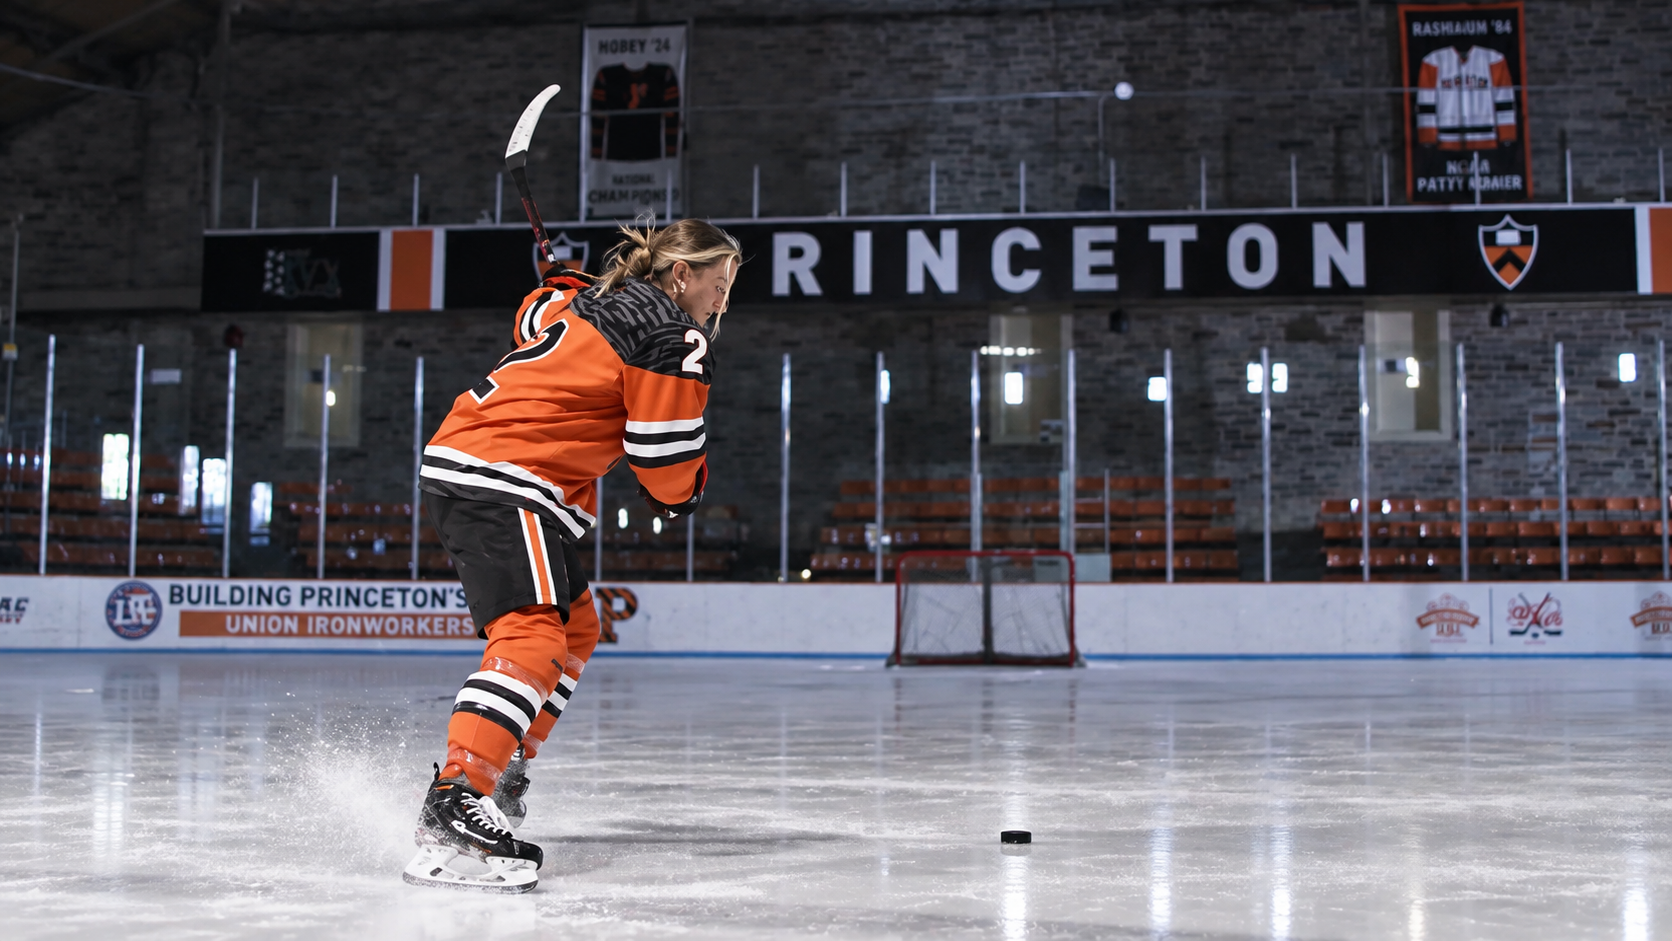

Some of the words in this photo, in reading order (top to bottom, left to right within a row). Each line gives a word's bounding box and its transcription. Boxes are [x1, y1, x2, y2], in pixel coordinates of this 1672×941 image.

[598, 39, 647, 54] HOBEY
[772, 221, 1367, 296] RINCETON
[681, 328, 708, 375] 2
[169, 583, 292, 606] BUILDING
[300, 584, 468, 609] PRINCETON'S
[225, 614, 298, 634] UNION
[307, 615, 475, 636] IRONWORKERS
